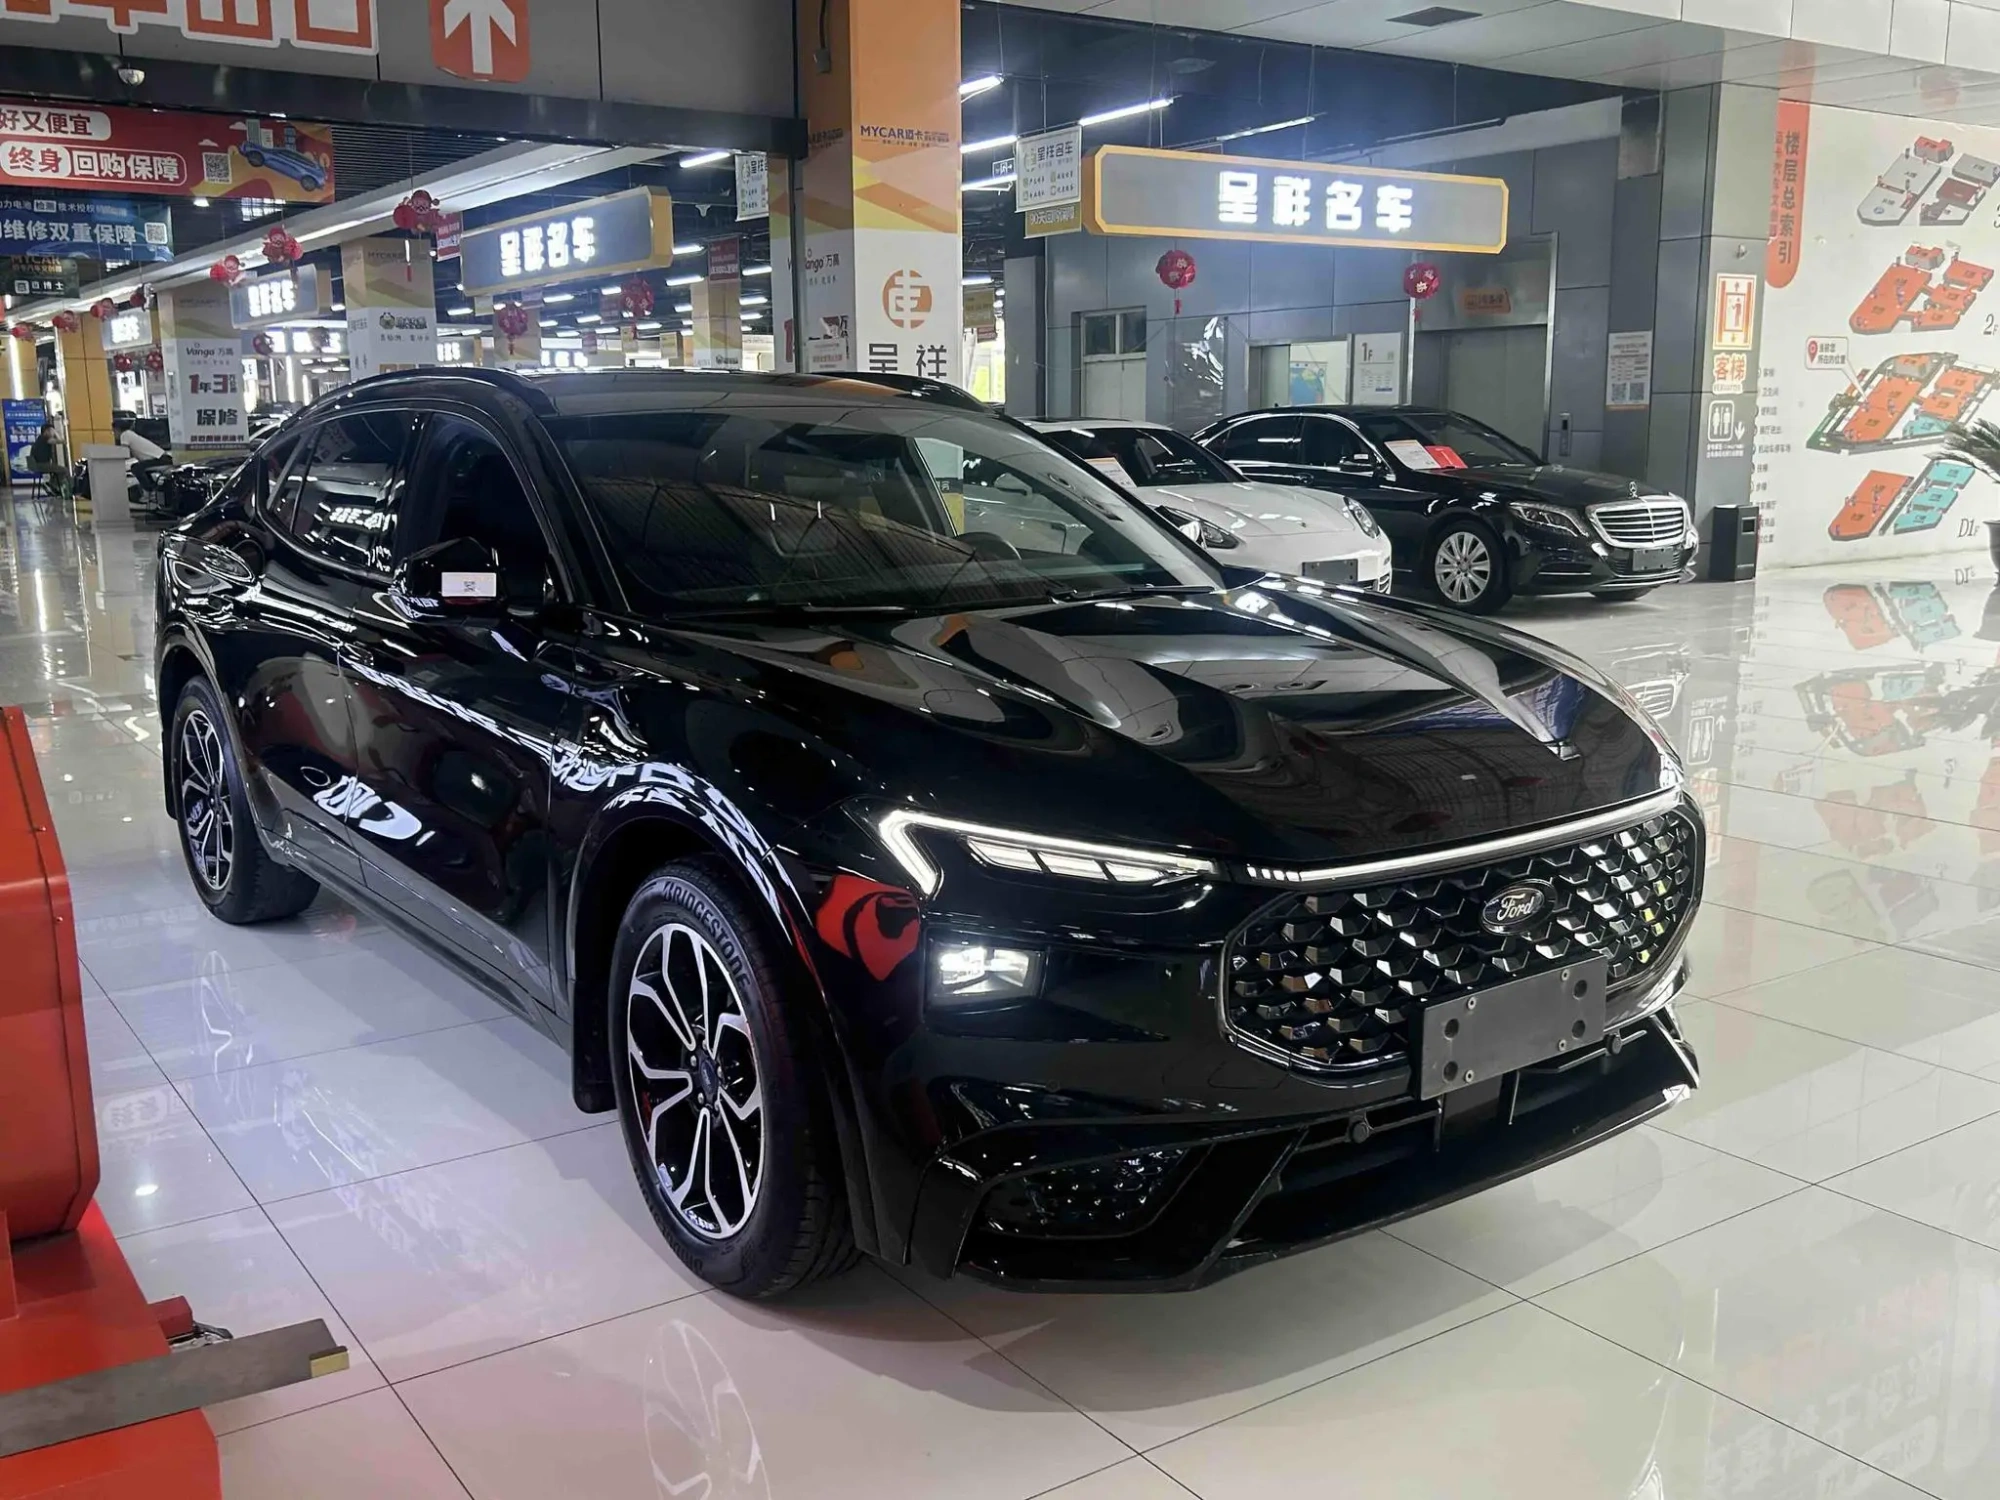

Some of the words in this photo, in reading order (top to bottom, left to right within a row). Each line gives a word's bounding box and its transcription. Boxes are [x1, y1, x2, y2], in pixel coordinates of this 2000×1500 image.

[0, 108, 93, 137] 好又便宜
[8, 145, 180, 182] 终身回购保障
[1778, 130, 1800, 265] 楼层总索引
[0, 219, 137, 245] 维修双重保障
[868, 344, 947, 379] 呈祥
[1714, 354, 1747, 381] 客梯
[196, 408, 238, 427] 保修
[1496, 893, 1535, 921] Ford
